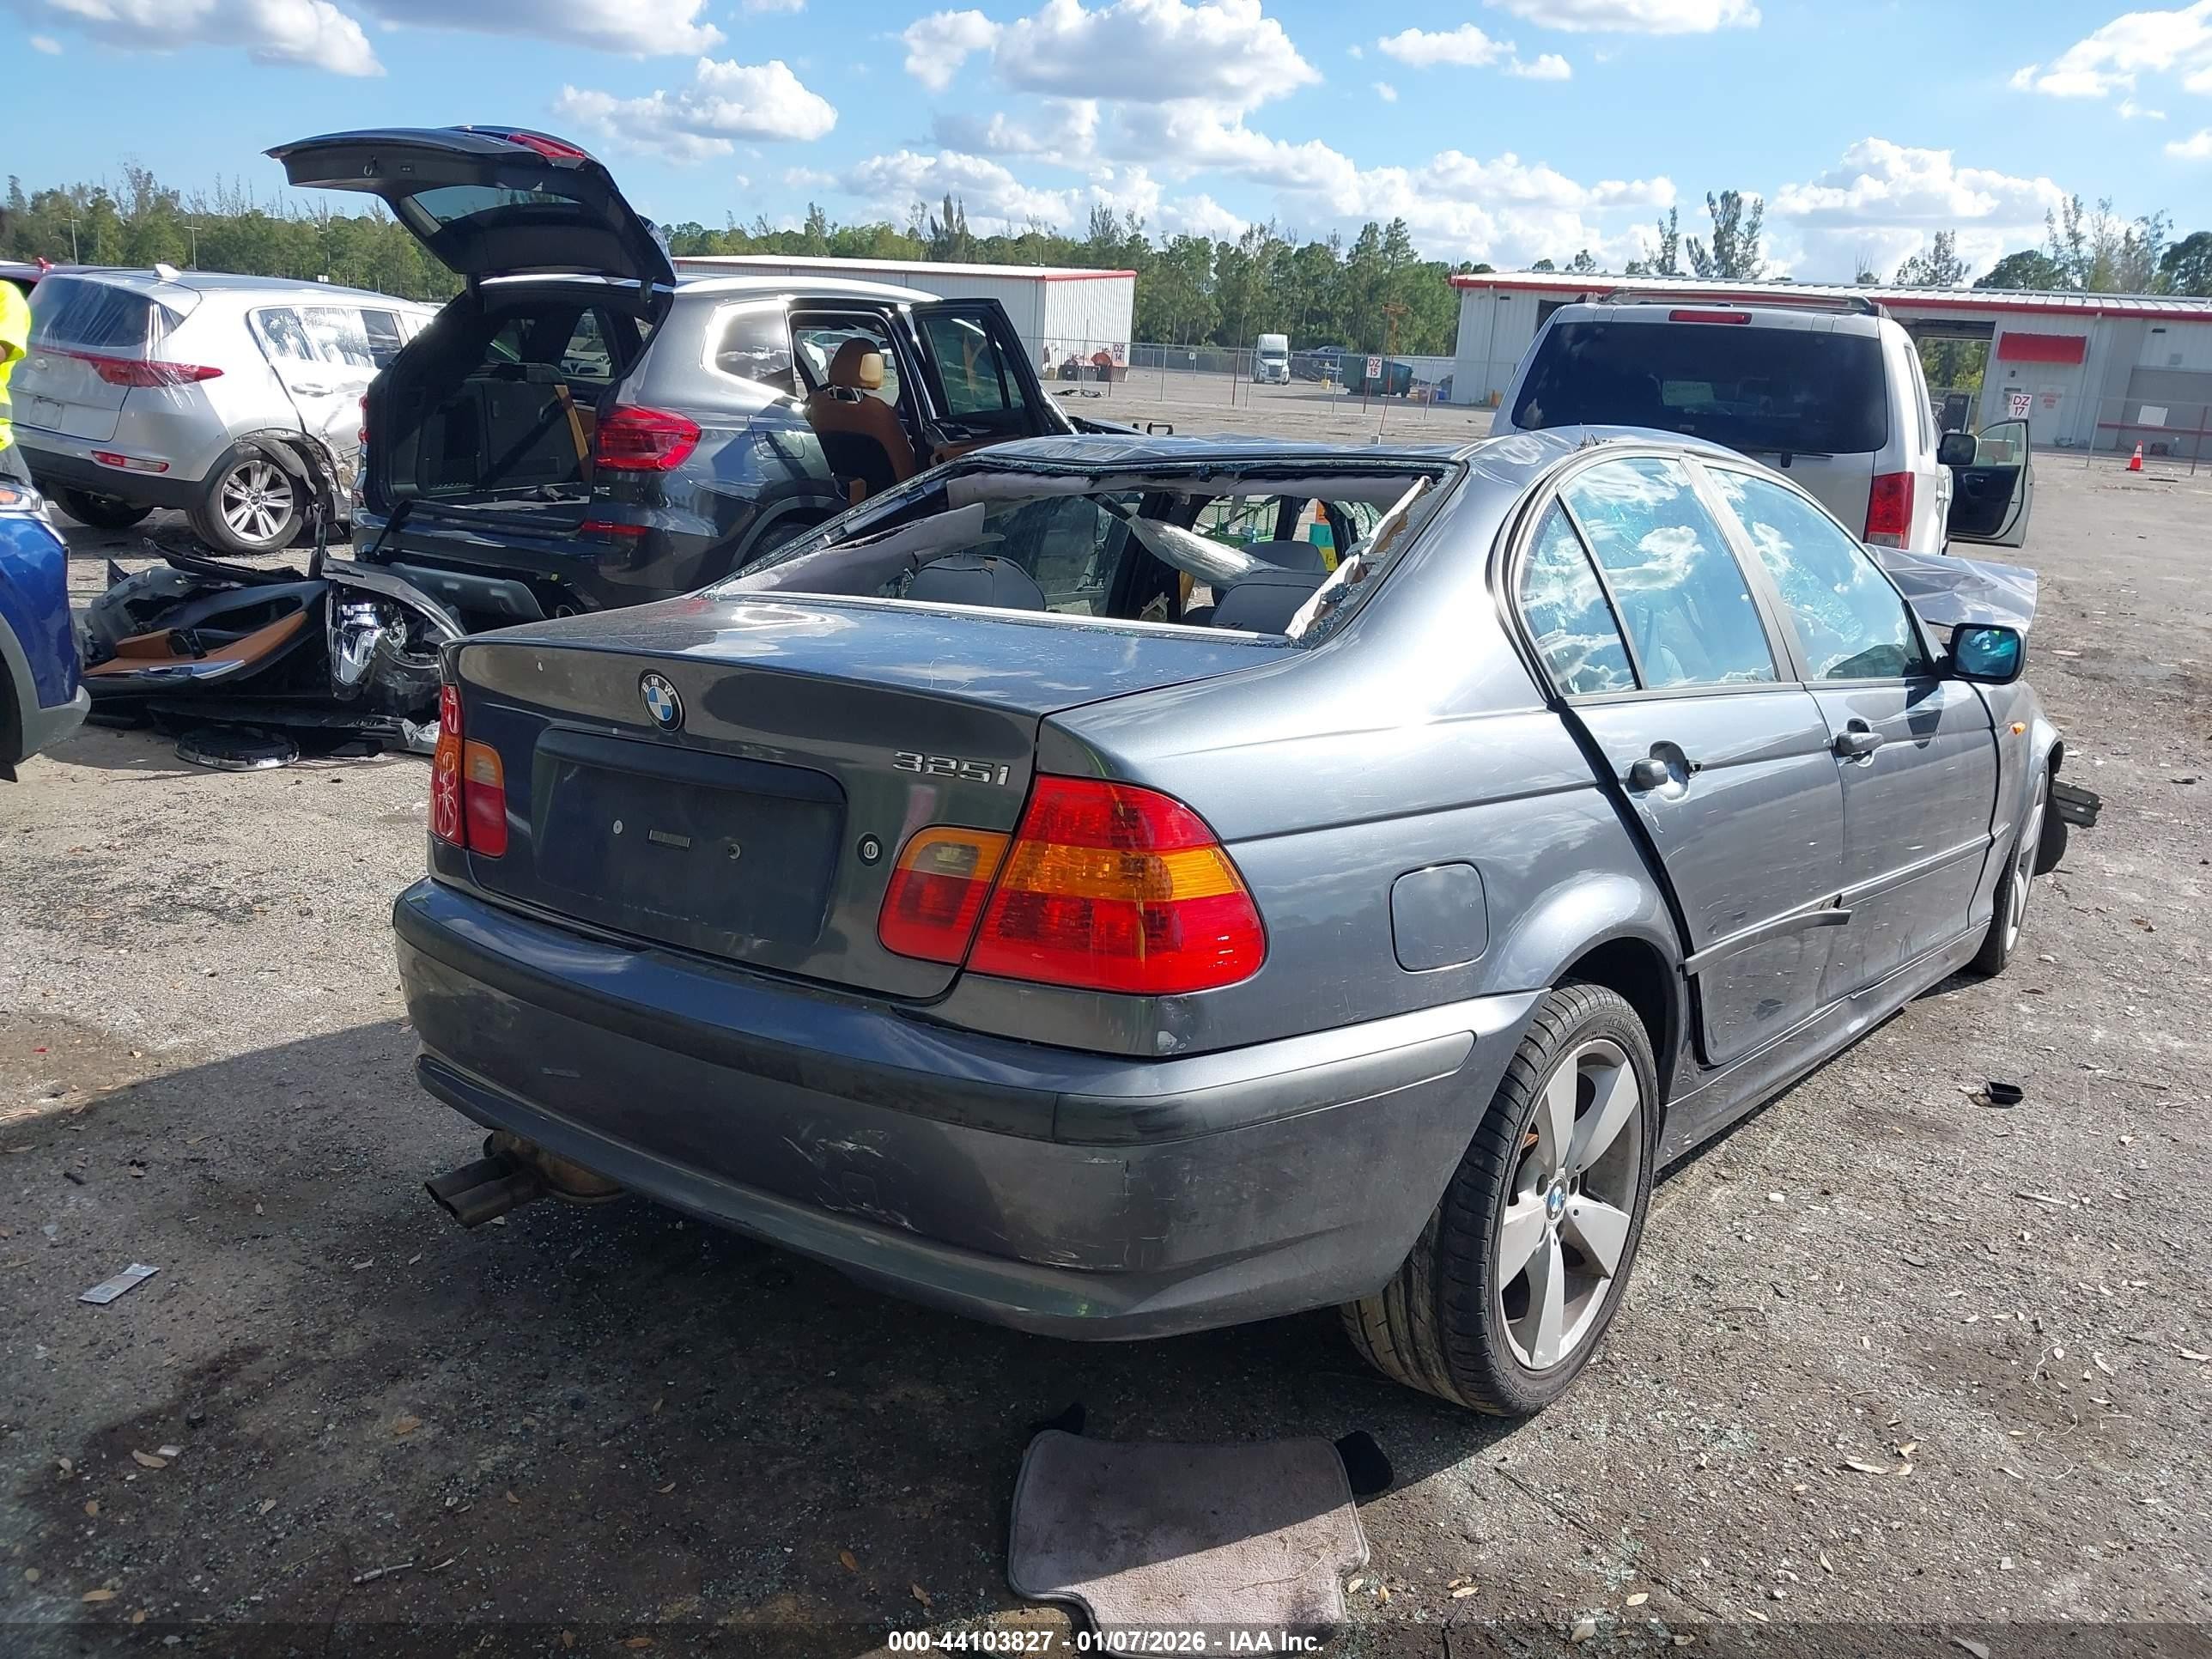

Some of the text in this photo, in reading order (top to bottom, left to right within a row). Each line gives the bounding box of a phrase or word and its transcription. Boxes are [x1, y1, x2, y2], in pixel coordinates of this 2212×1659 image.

[1113, 343, 1125, 352] DZ
[1368, 358, 1381, 368] DZ
[1370, 368, 1378, 376] 15
[2013, 396, 2030, 406] DZ
[2014, 406, 2025, 416] 17
[641, 677, 674, 696] BMW
